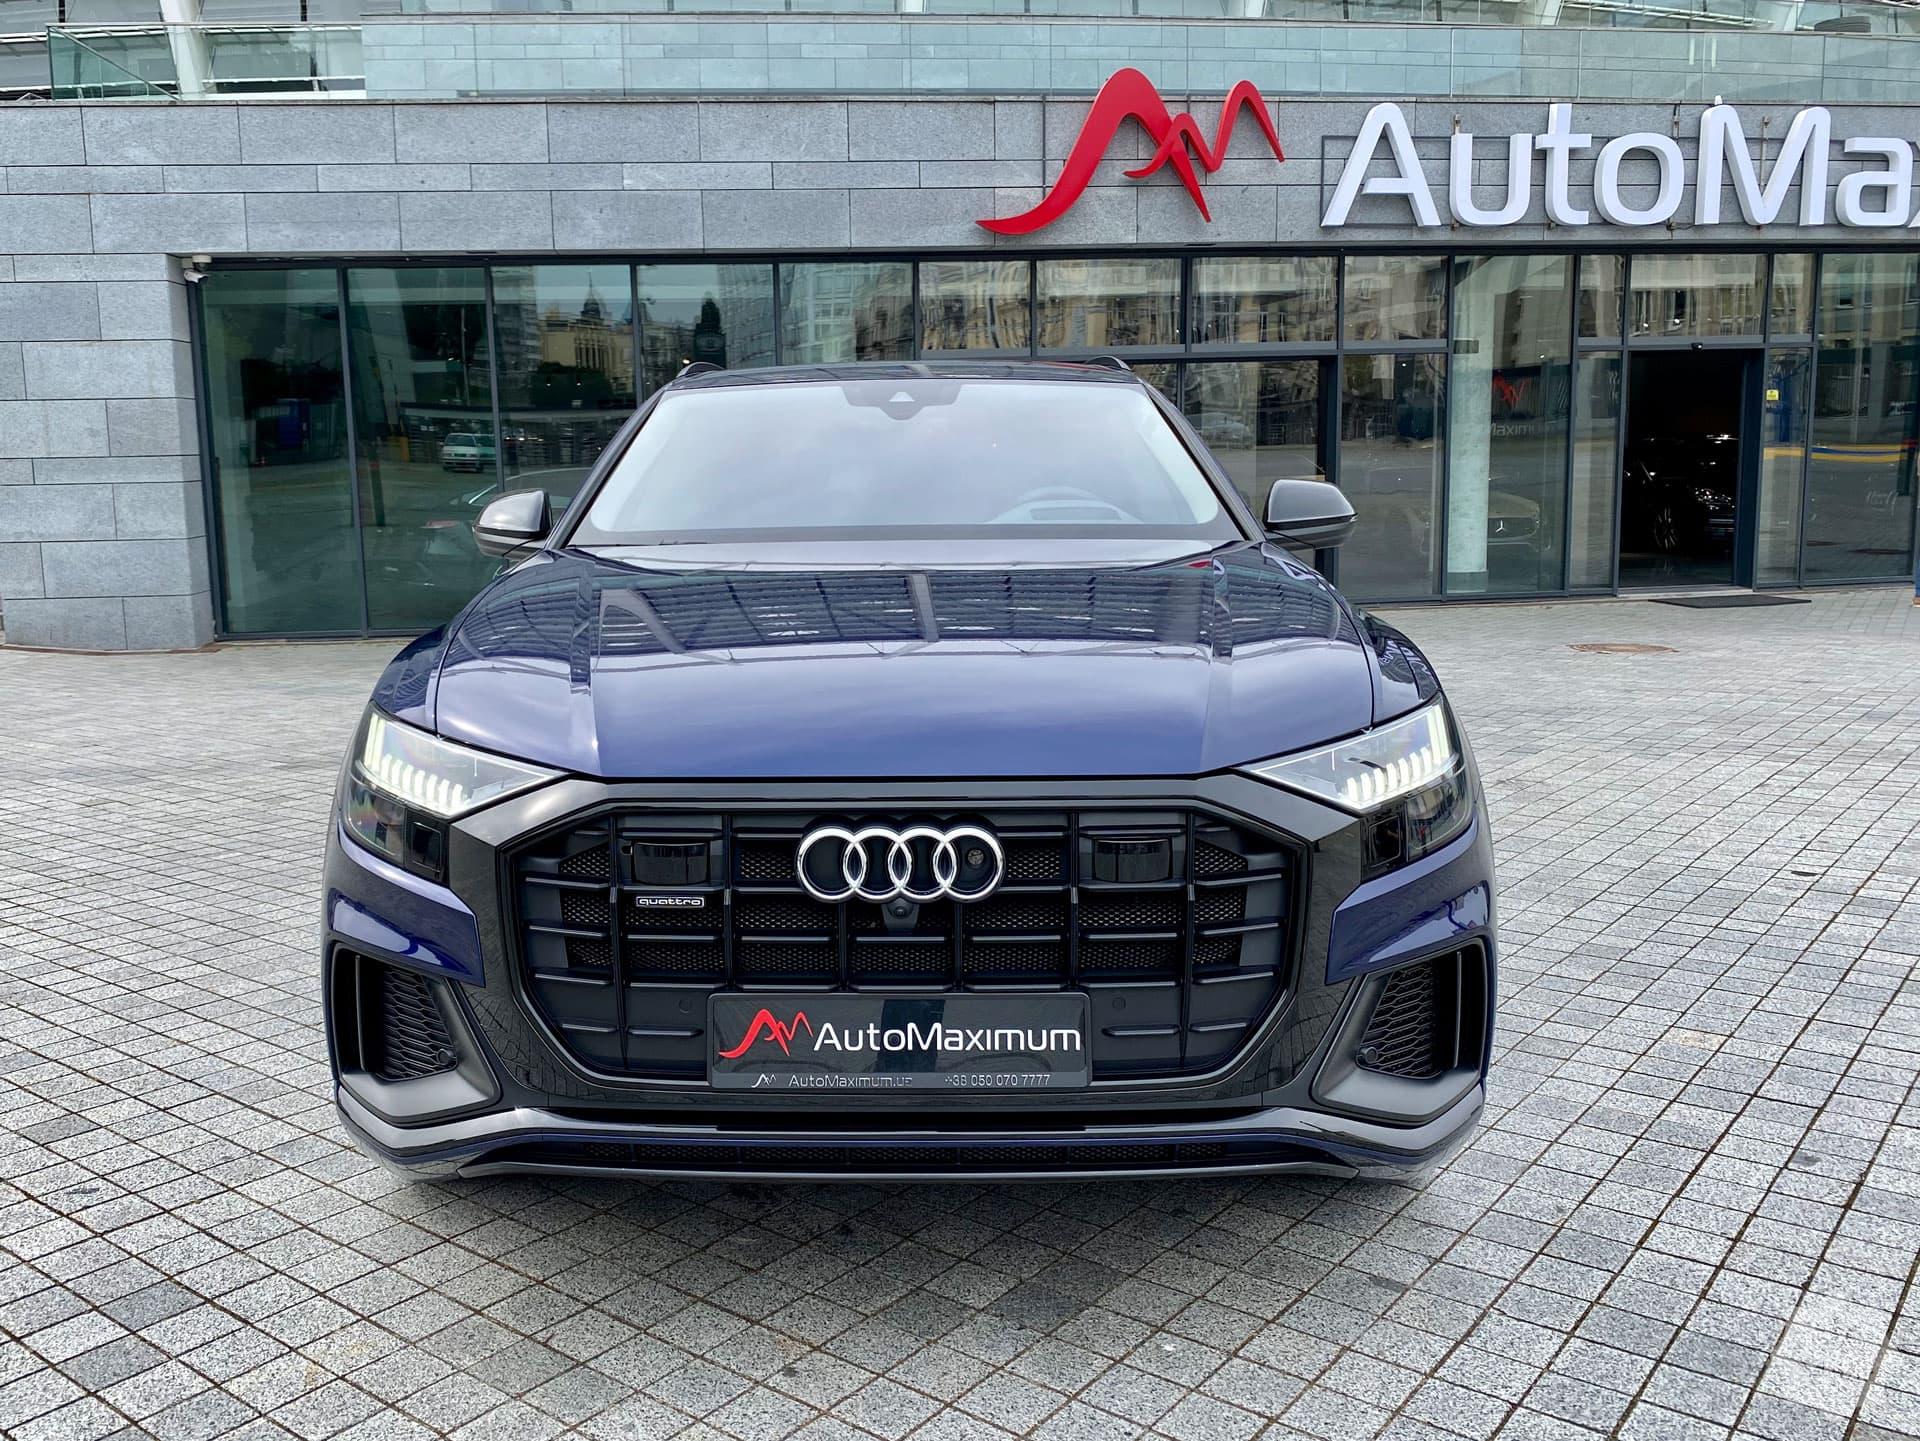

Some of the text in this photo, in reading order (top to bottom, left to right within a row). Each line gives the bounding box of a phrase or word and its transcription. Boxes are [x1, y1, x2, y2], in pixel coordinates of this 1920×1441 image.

[1321, 102, 1920, 228] AutoMa
[639, 898, 701, 906] quattro
[813, 1021, 1082, 1052] AutoMaximum
[970, 1074, 993, 1087] 050
[996, 1074, 1018, 1087] 070
[1021, 1074, 1051, 1087] 7777
